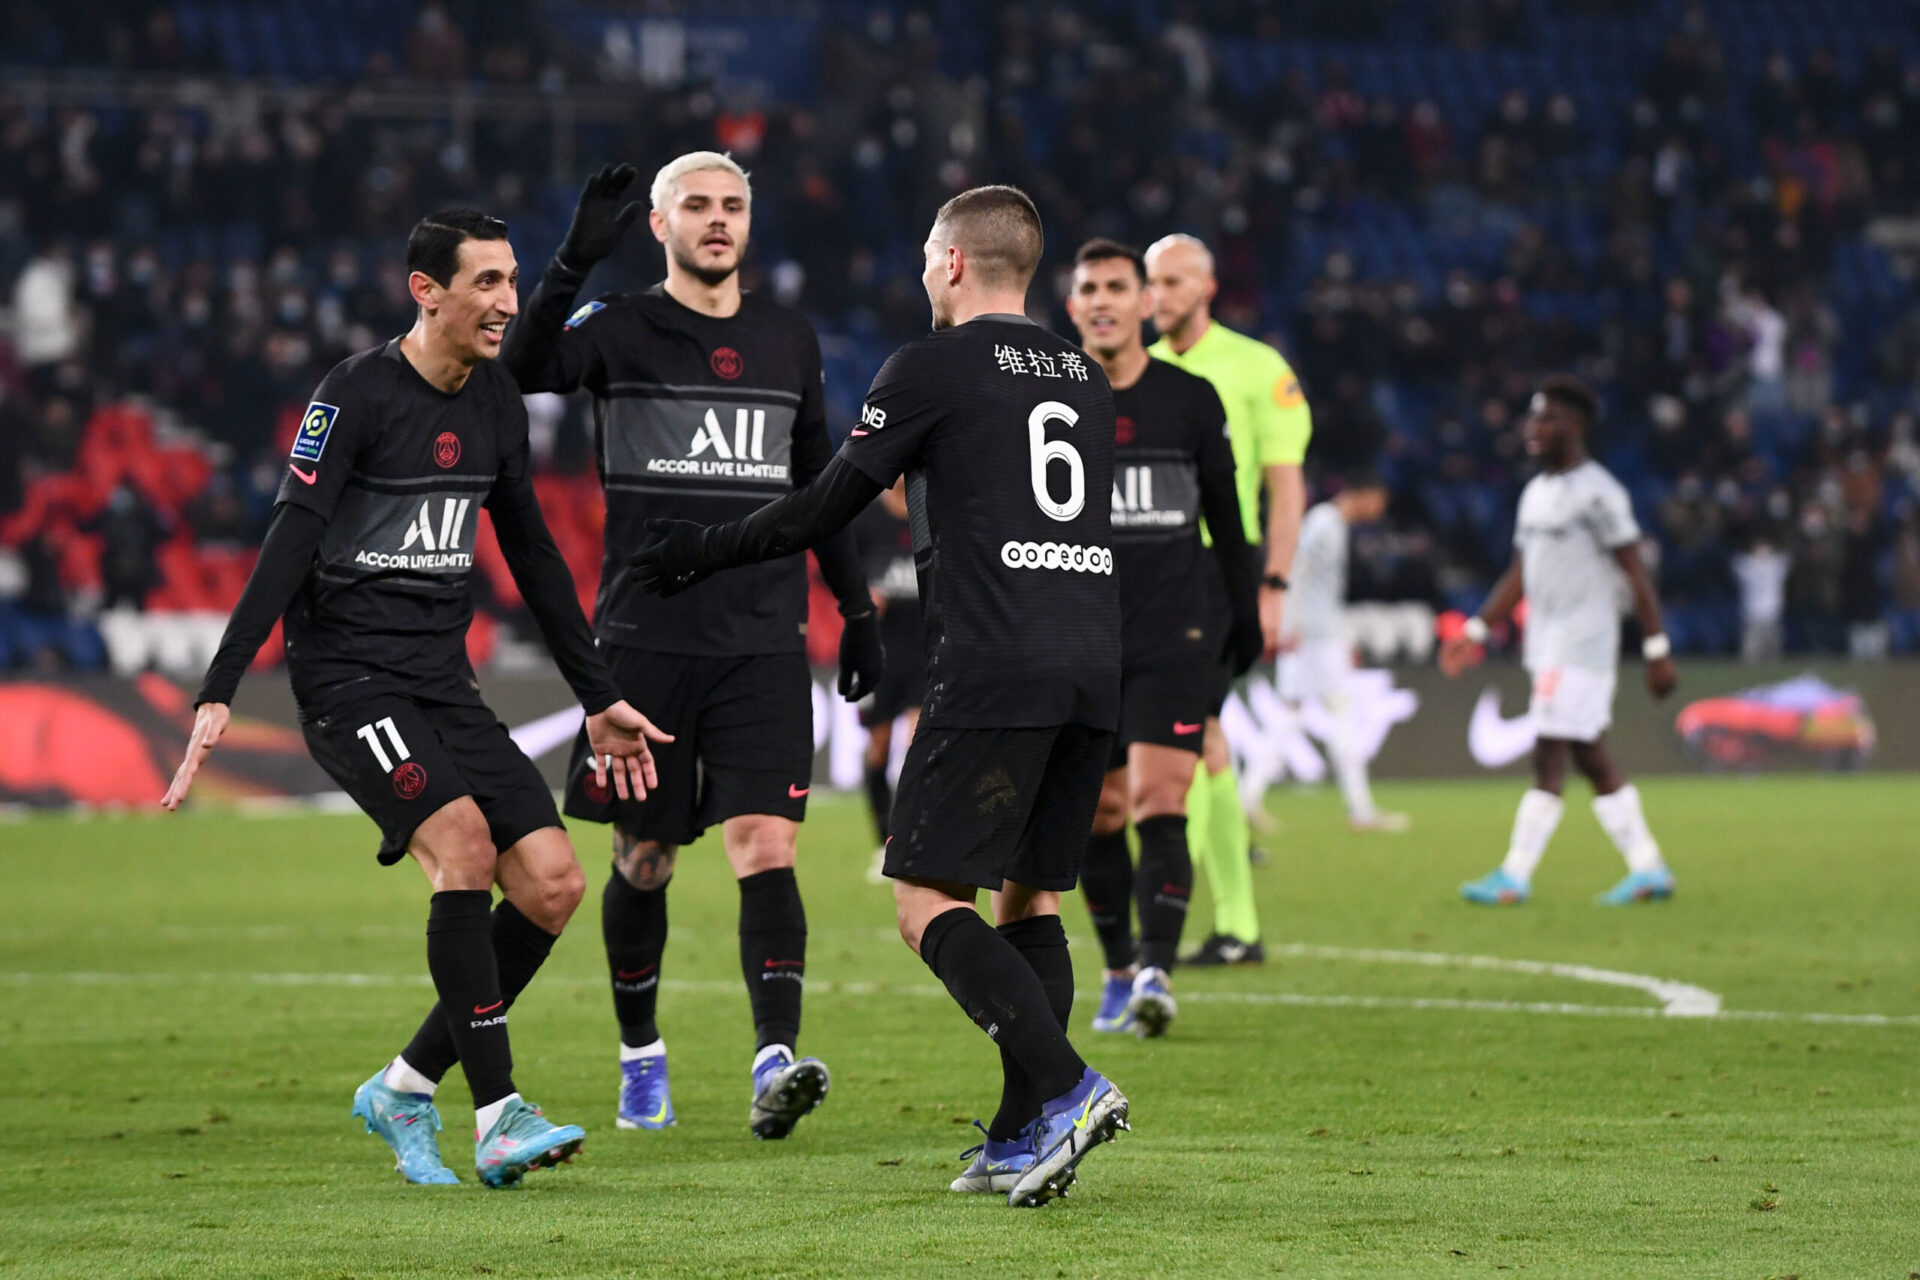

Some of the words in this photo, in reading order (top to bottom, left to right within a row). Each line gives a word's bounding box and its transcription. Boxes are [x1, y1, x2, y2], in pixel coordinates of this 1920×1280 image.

[994, 343, 1089, 382] 维拉蒂
[646, 458, 700, 474] ACCOR
[702, 461, 734, 476] LIVE
[1028, 401, 1086, 522] 6
[355, 550, 409, 569] ACCOR
[410, 554, 434, 569] LIVE
[434, 553, 474, 567] LIMITL
[1003, 542, 1112, 573] ooredoo
[356, 716, 411, 774] 11
